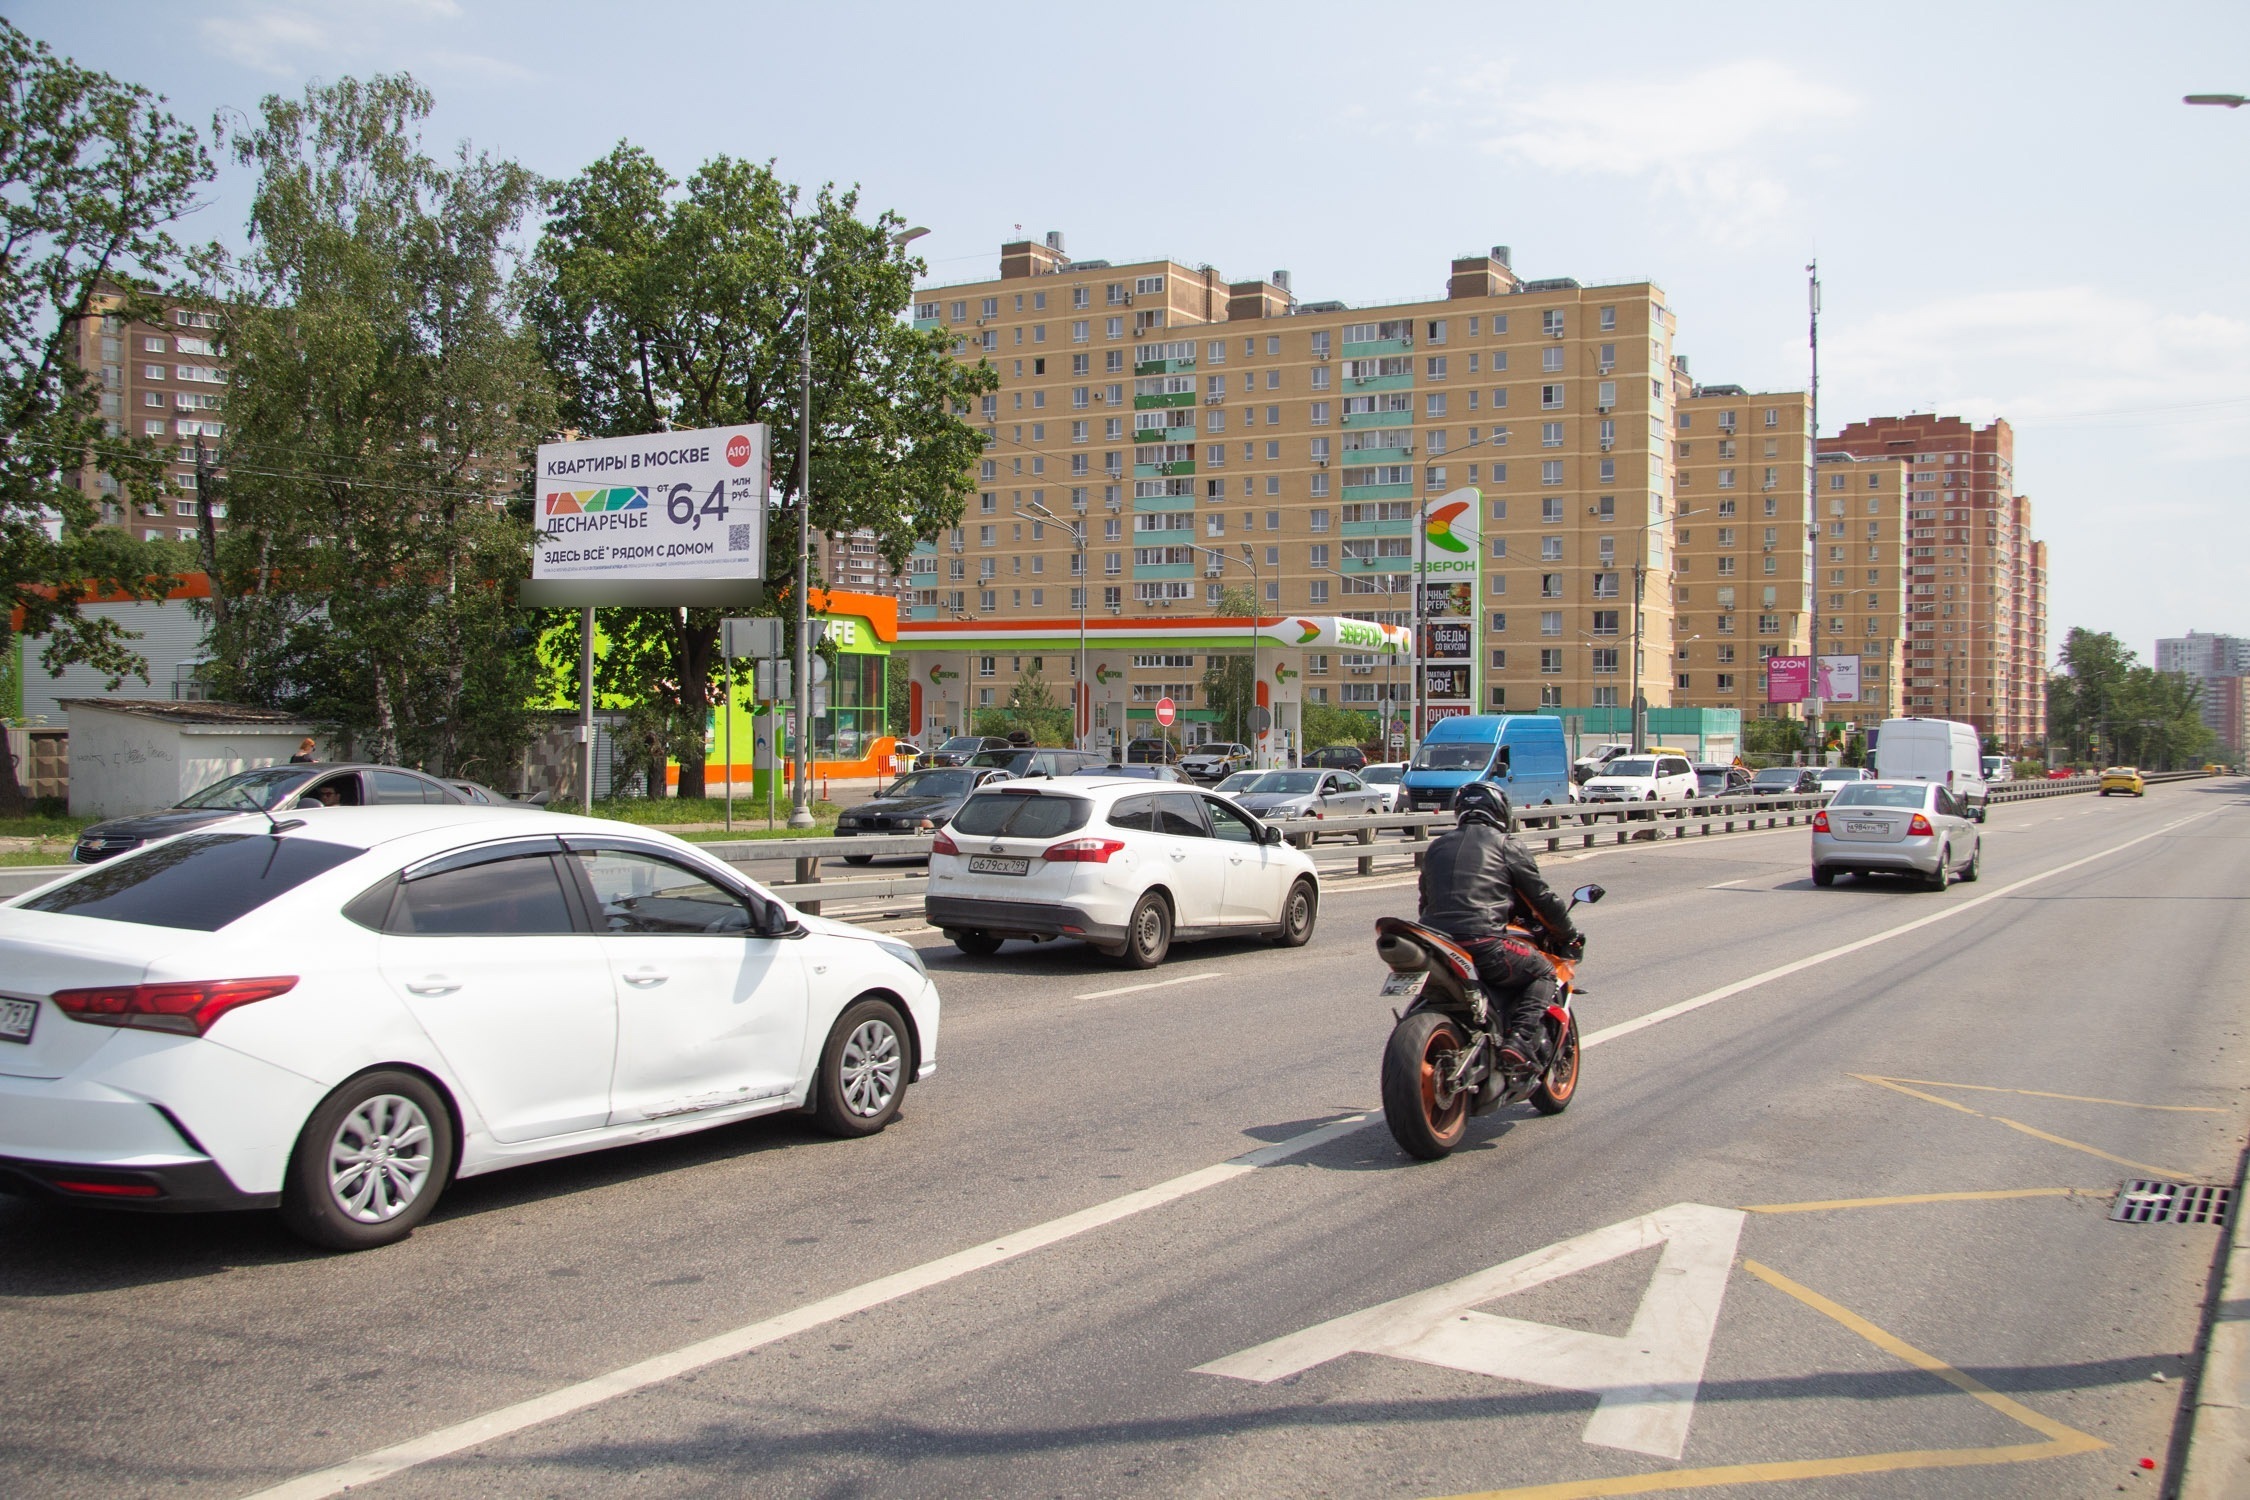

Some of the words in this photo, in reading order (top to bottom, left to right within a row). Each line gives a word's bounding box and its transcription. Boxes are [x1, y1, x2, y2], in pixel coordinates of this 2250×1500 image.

[727, 445, 750, 458] А101
[547, 454, 627, 476] КВАРТИРЫ
[631, 453, 641, 469] В
[644, 446, 710, 467] МОСКВЕ
[731, 477, 751, 486] млн
[731, 488, 751, 501] руб.
[656, 484, 669, 492] от
[667, 479, 729, 531] 6,4
[546, 512, 648, 534] ДЕСНАРЕЧЬЕ
[544, 550, 581, 564] ЗДЕСЬ
[612, 545, 654, 560] РЯДОМ
[656, 545, 664, 557] С
[666, 542, 714, 557] ДОМОМ
[1339, 621, 1382, 648] ЭВЕРОН
[1435, 630, 1467, 643] ОБЕДЫ
[1435, 643, 1443, 651] СО
[1444, 642, 1467, 651] ВКУСОМ
[1771, 660, 1806, 669] OZON
[1427, 679, 1451, 693] ОФЕ
[1426, 708, 1465, 721] ОНУСЫ
[1011, 861, 1026, 869] 799
[1450, 952, 1472, 972] REPSOL
